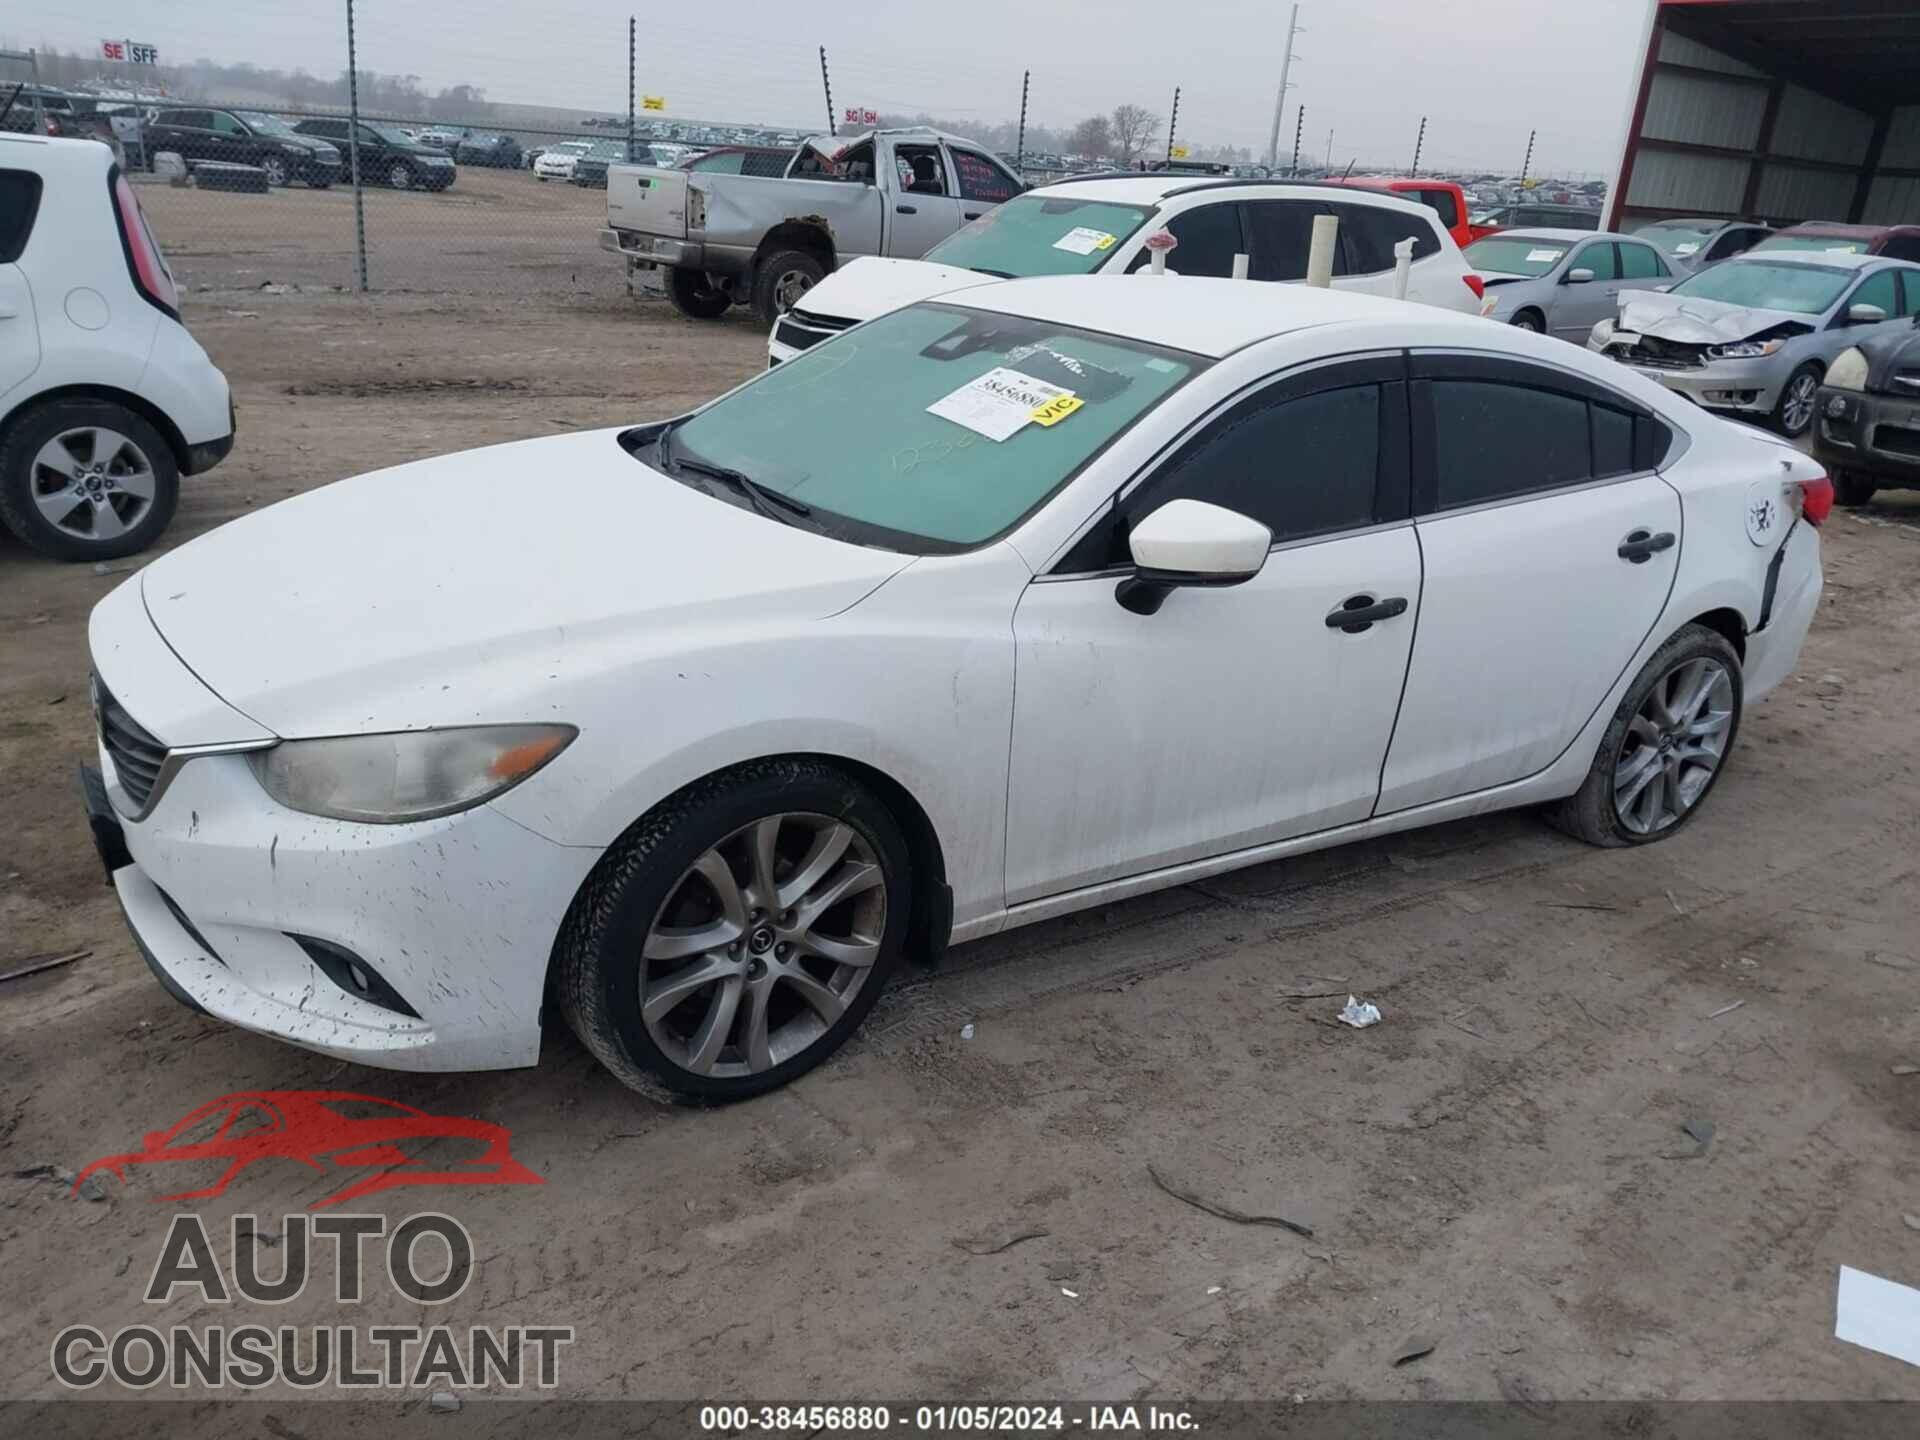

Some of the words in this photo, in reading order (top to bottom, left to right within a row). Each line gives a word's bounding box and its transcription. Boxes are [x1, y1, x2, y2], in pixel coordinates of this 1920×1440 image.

[103, 42, 124, 60] SE
[132, 46, 158, 64] SFF
[846, 110, 858, 122] SG
[864, 111, 877, 124] SH
[1034, 398, 1075, 419] VIC
